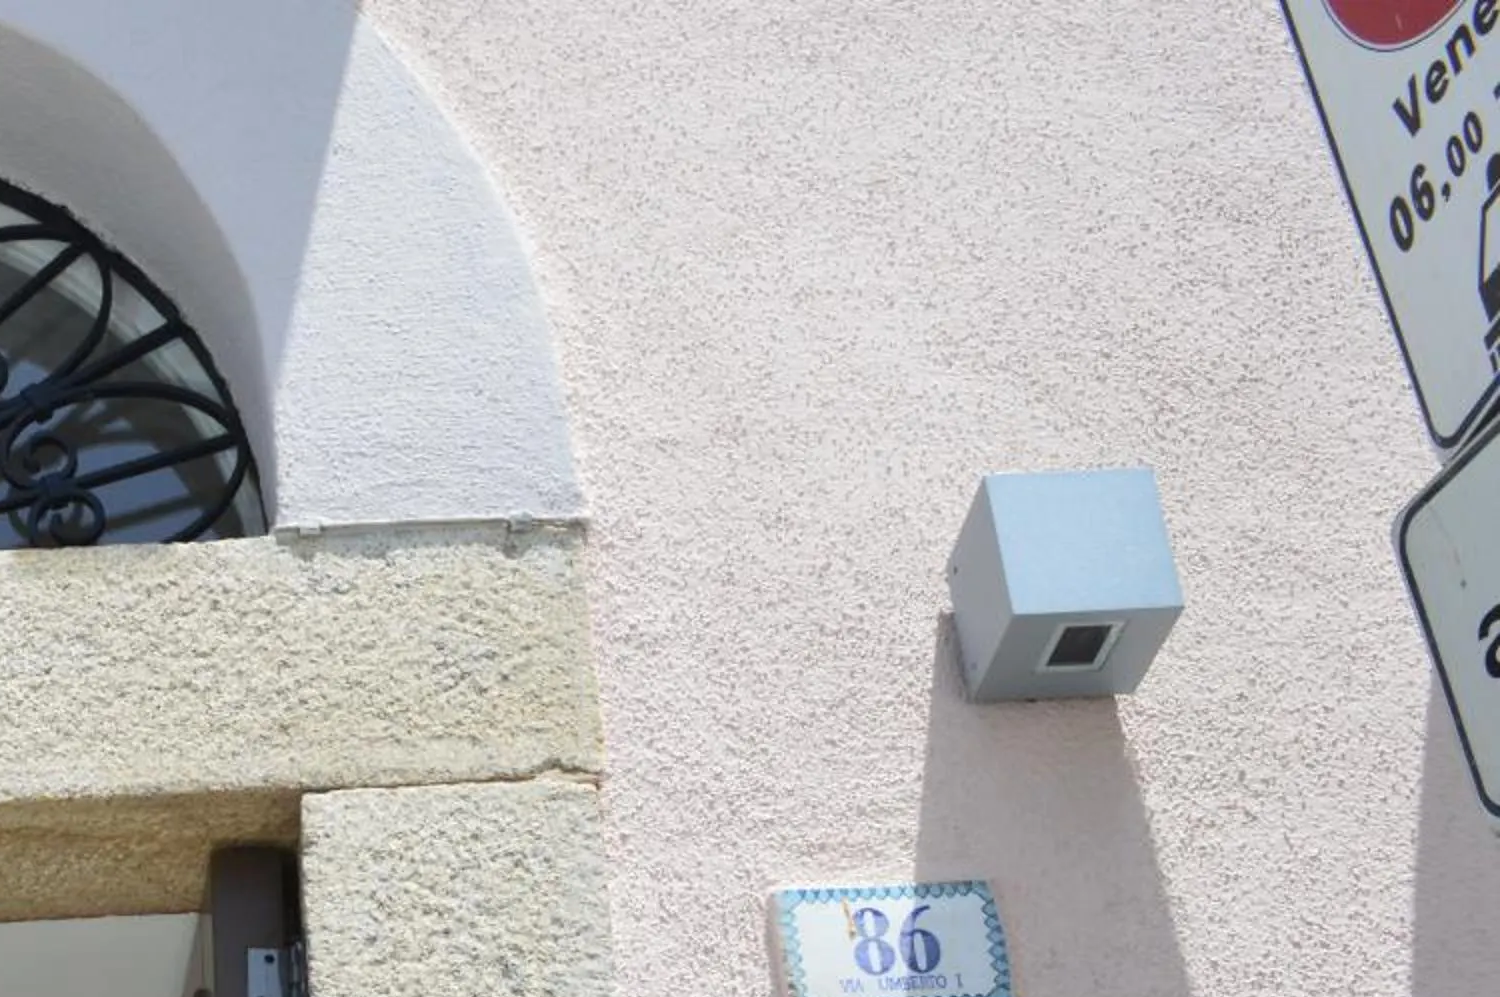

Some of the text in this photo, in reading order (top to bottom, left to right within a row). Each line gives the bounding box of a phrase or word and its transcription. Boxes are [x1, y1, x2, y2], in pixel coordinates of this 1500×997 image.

[853, 904, 942, 976] 86
[839, 977, 864, 993] VIA
[878, 973, 948, 992] UMBERTO
